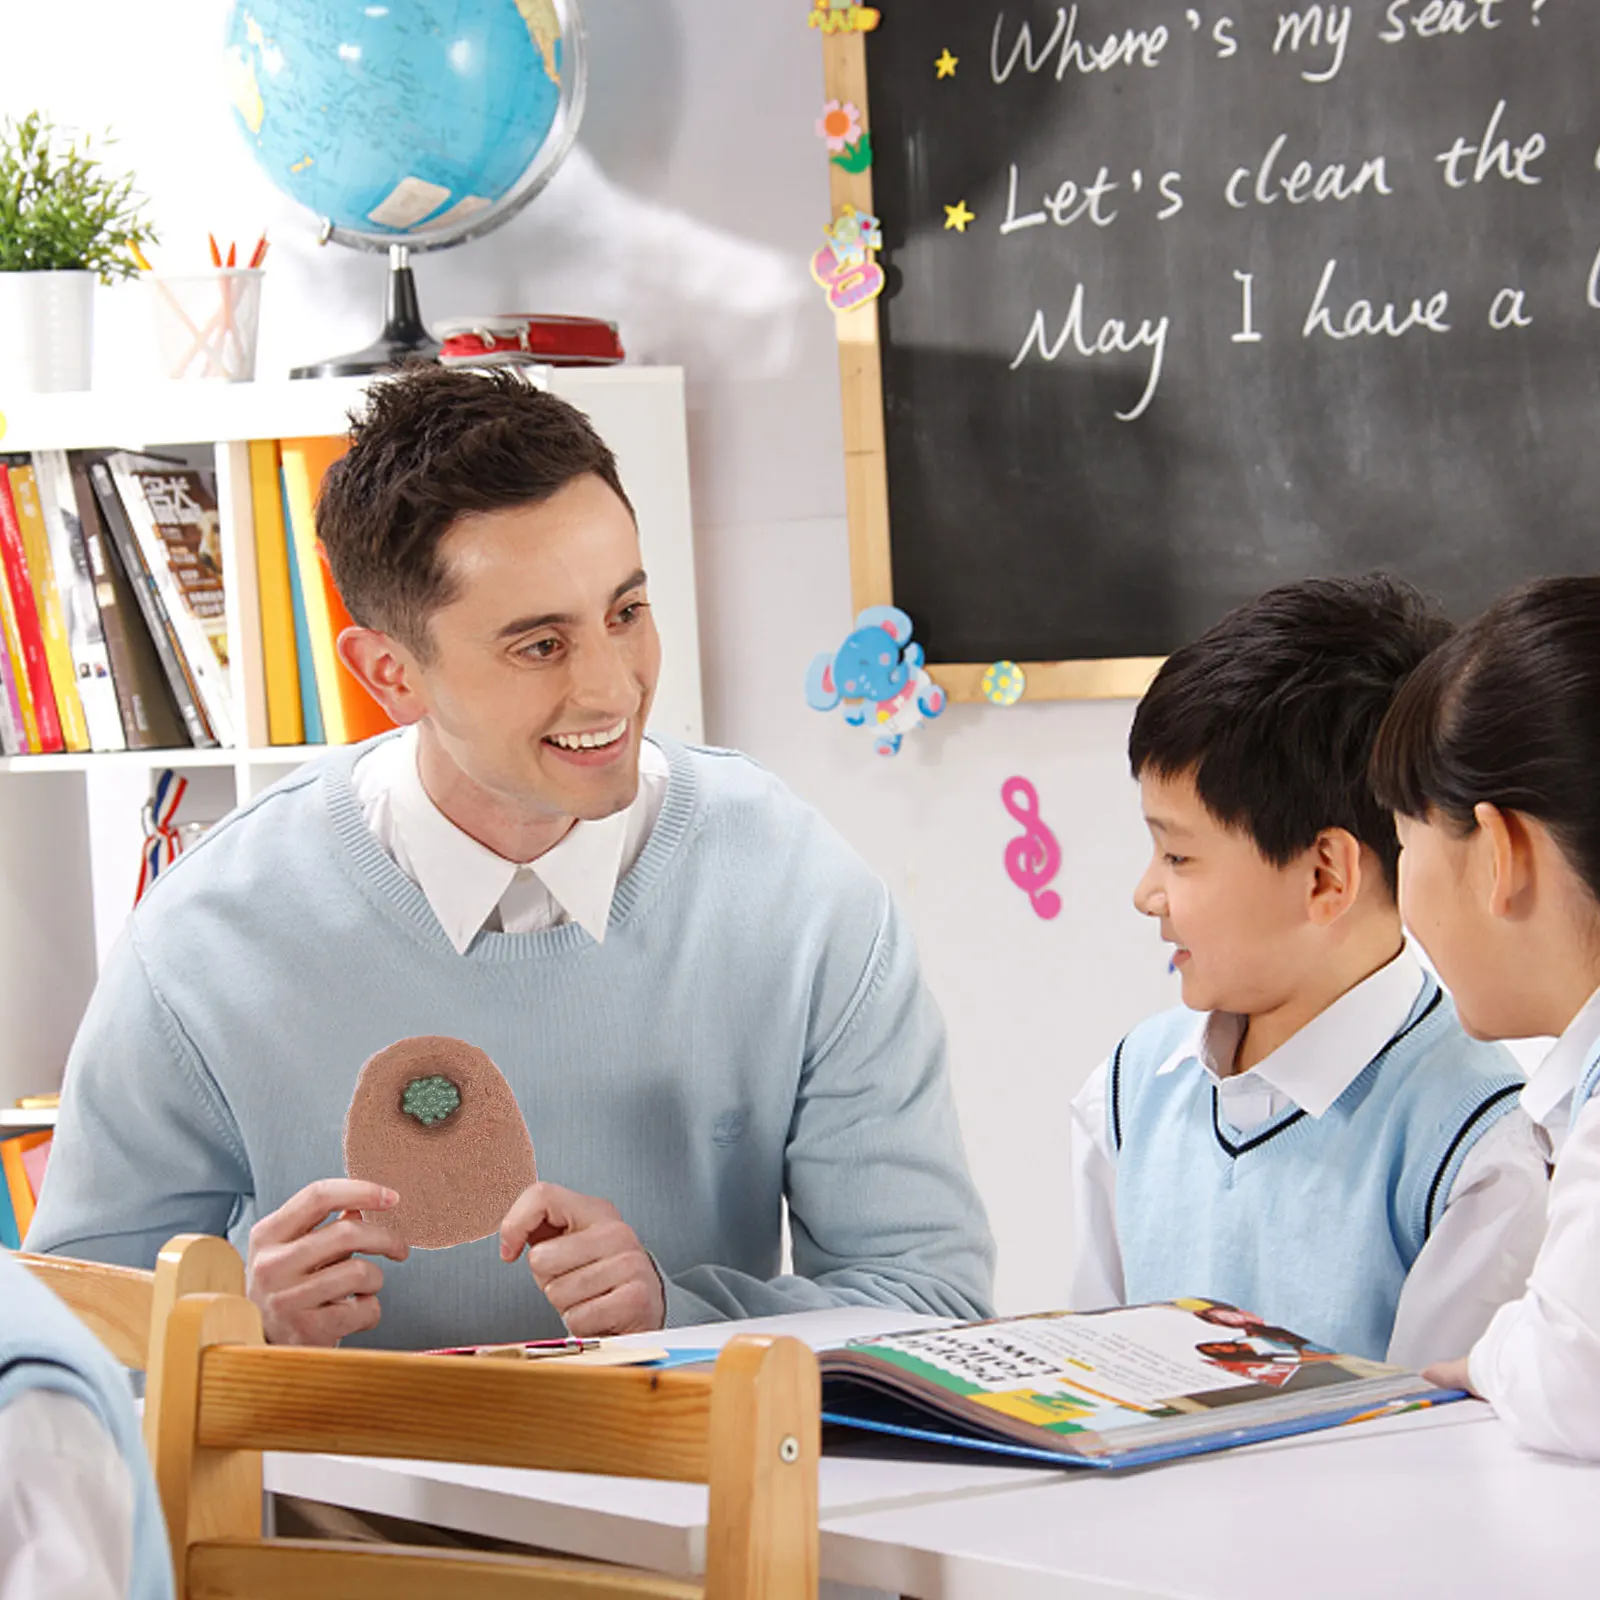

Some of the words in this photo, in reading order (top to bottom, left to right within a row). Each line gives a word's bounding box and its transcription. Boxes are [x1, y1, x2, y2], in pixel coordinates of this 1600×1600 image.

[990, 4, 1237, 84] Where's
[1271, 5, 1351, 82] my
[1000, 163, 1184, 234] Let's
[1224, 133, 1392, 207] clean
[1435, 99, 1546, 188] the
[1009, 282, 1169, 421] May
[1230, 269, 1263, 342] I
[1302, 258, 1451, 340] have
[1488, 288, 1533, 330] a
